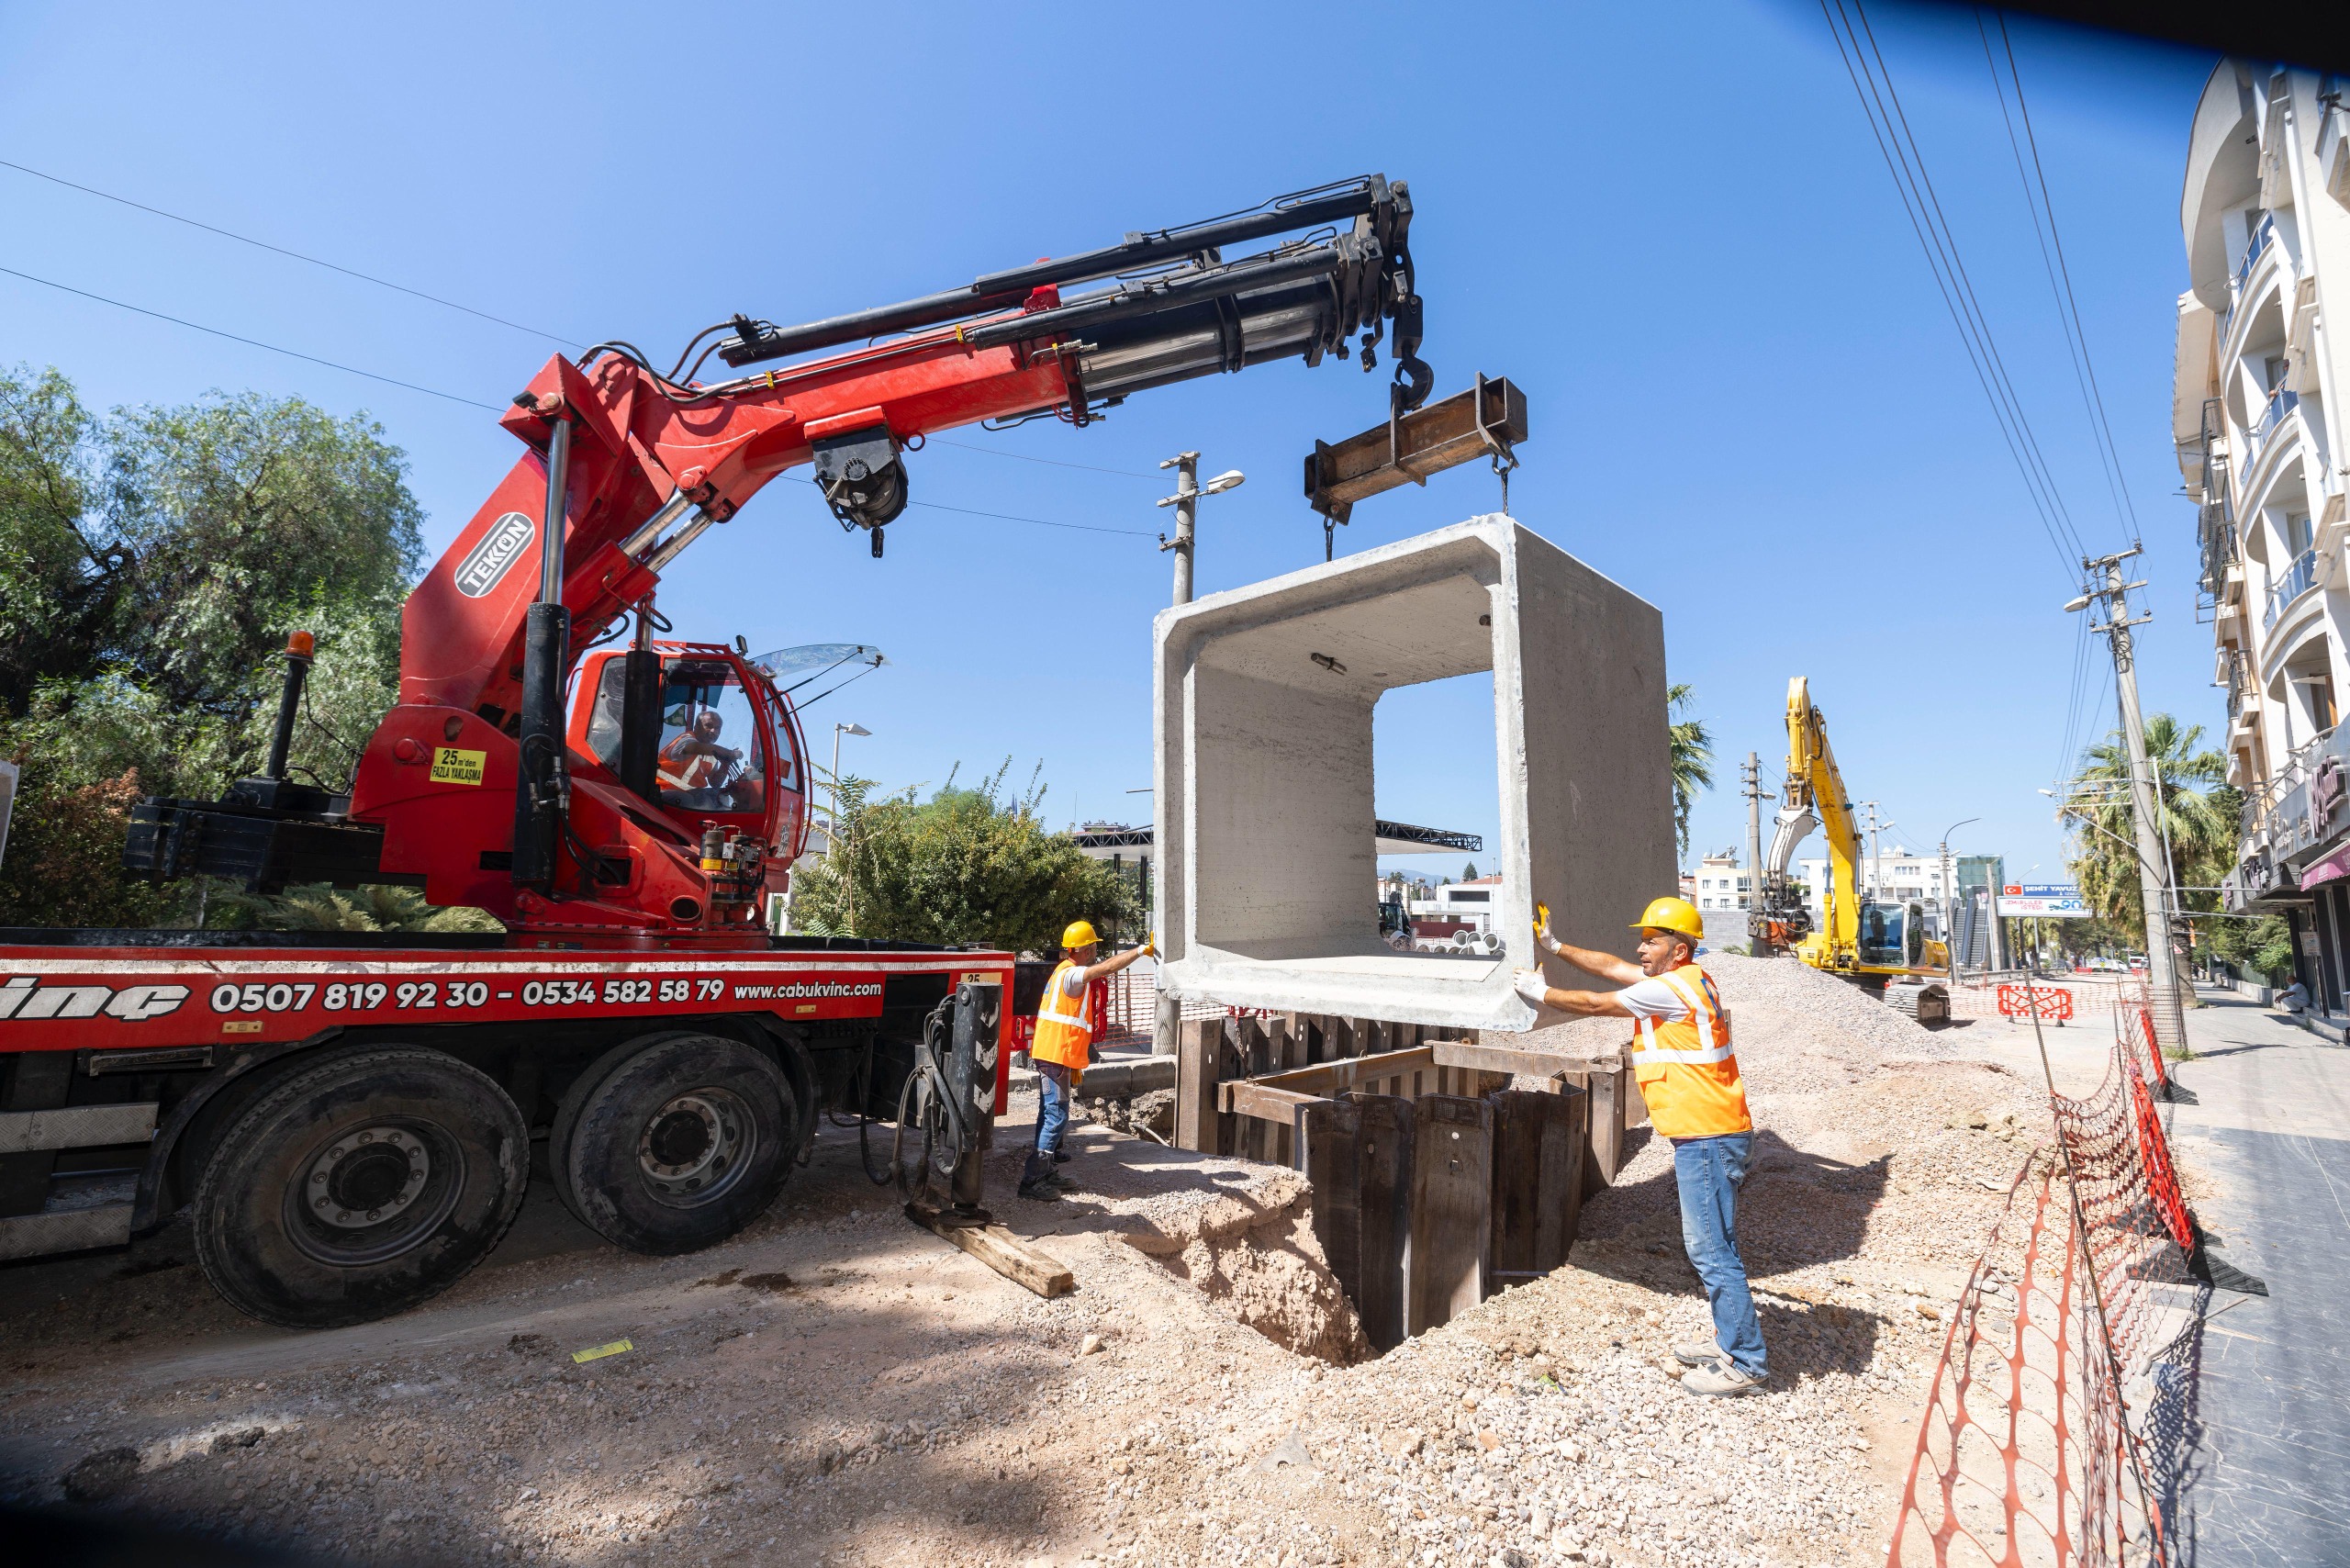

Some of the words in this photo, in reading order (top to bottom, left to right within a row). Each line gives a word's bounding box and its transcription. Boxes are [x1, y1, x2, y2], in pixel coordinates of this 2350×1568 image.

[442, 749, 458, 766] 25
[431, 766, 450, 778] FAZLA
[451, 767, 481, 783] YAKLAŞMA
[211, 983, 316, 1013] 0507
[323, 982, 387, 1010] 819
[396, 982, 438, 1009] 92
[444, 981, 488, 1007] 30
[522, 980, 597, 1005] 0534
[602, 980, 652, 1003] 582
[657, 980, 690, 1002] 58
[696, 979, 725, 1001] 79
[734, 980, 882, 999] www.cabukvinc.com
